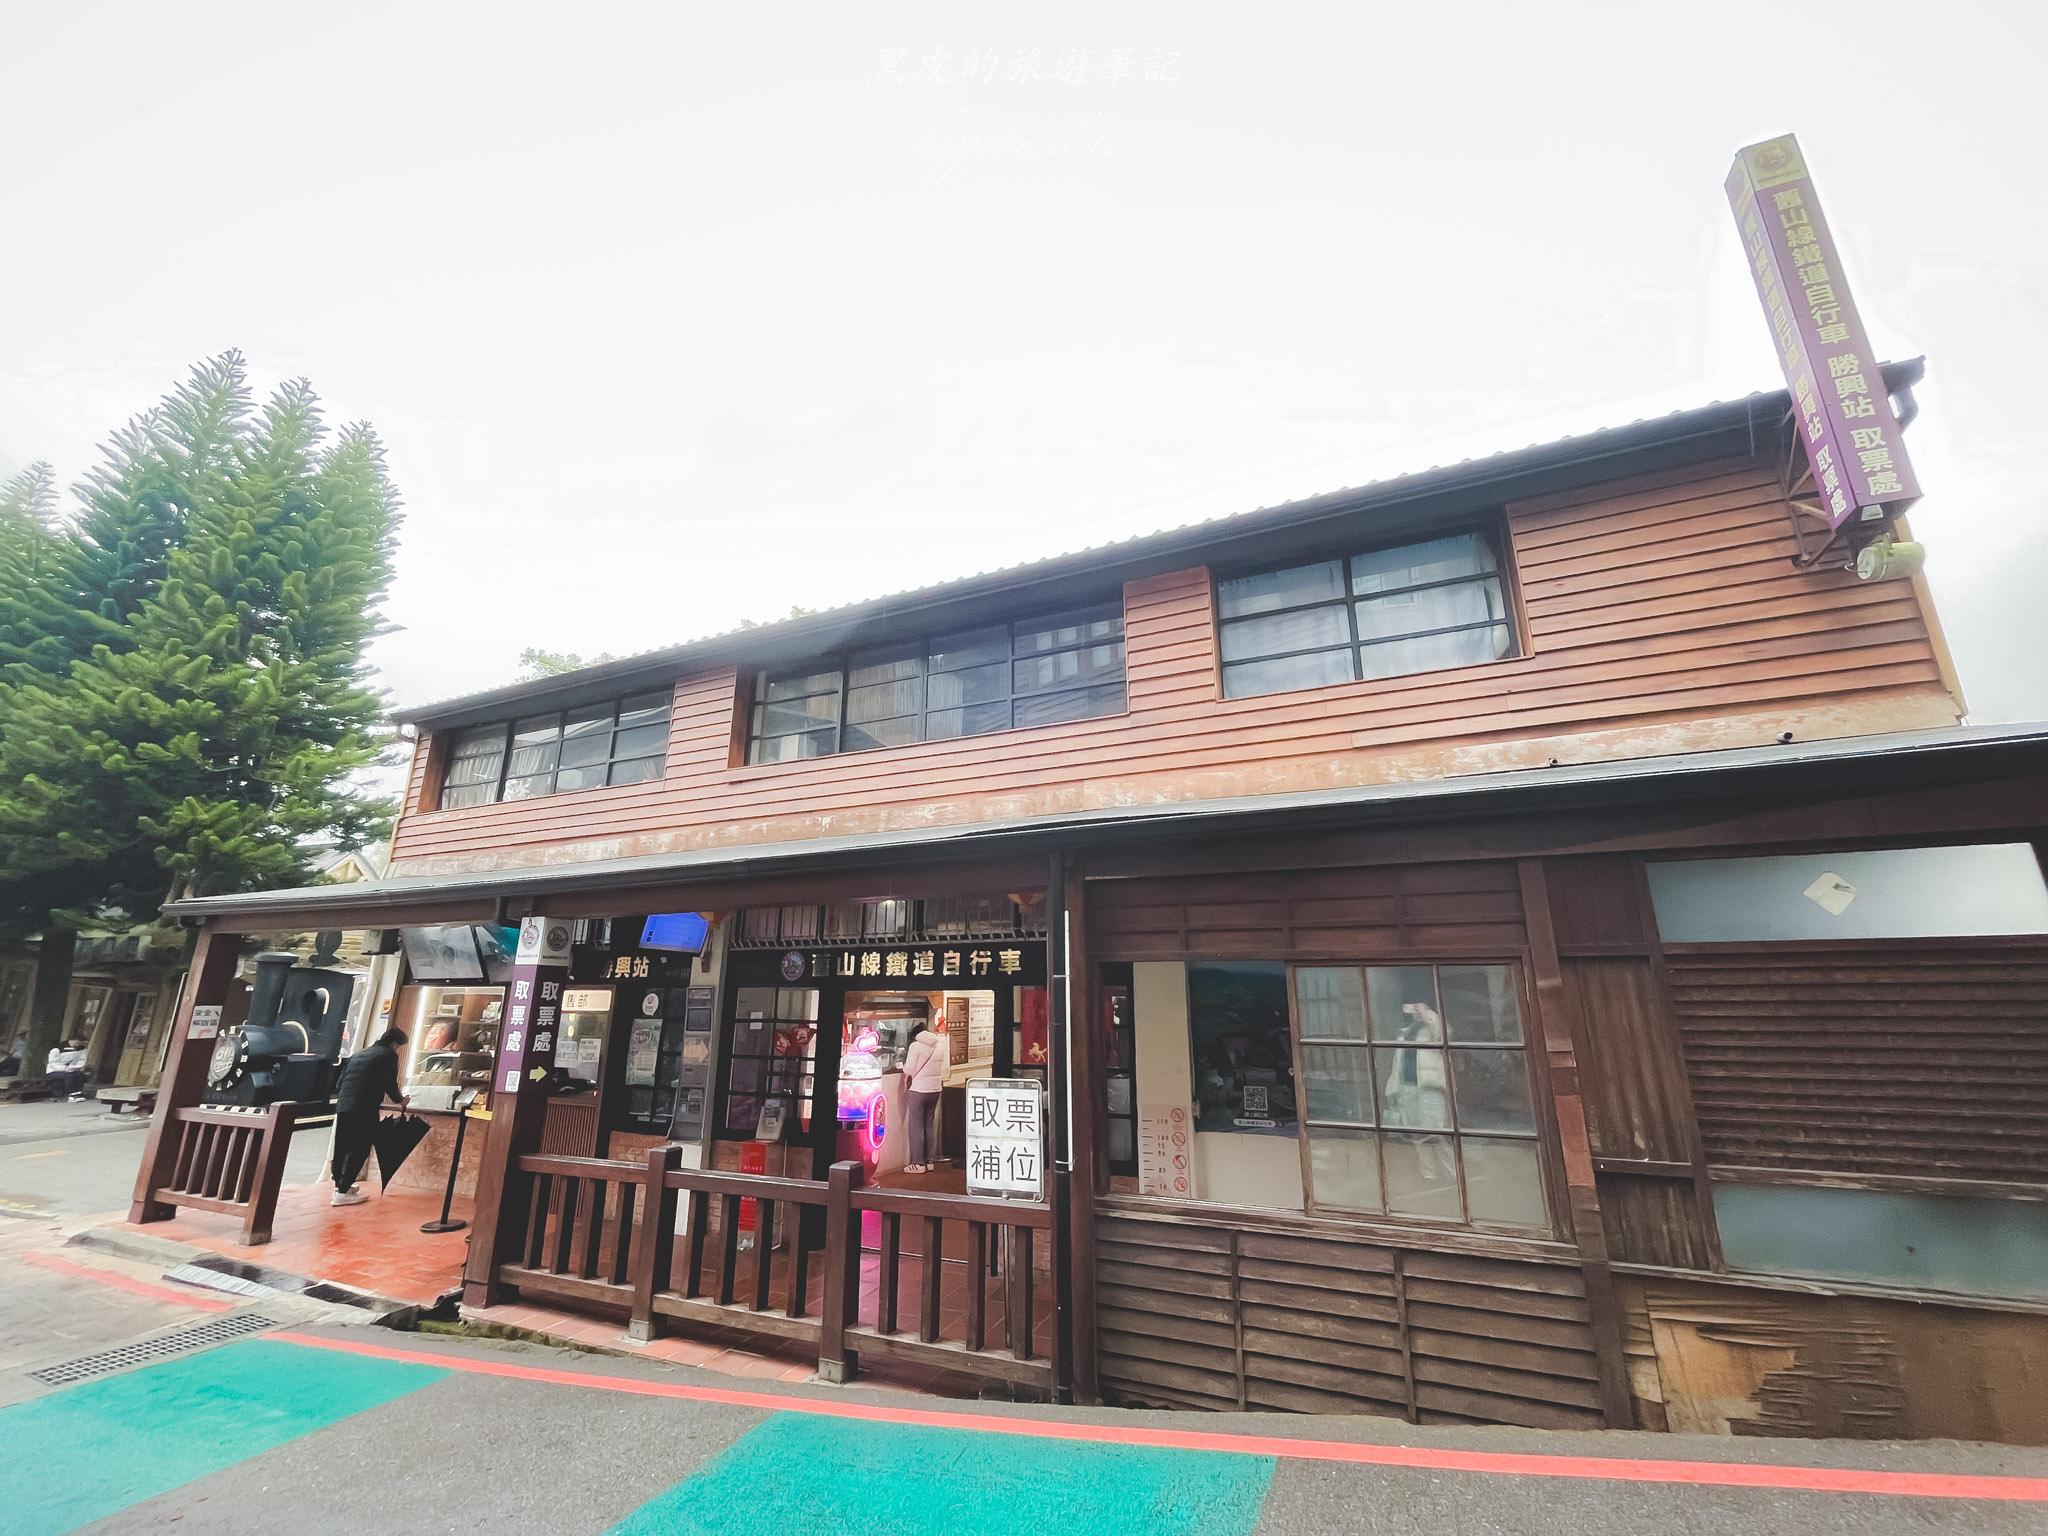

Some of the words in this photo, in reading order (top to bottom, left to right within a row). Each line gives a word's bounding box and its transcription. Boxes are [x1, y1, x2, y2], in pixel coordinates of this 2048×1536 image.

[1827, 353, 1875, 419] 勝興站
[1850, 425, 1902, 496] 取票處
[505, 980, 530, 1052] 取票處
[532, 981, 560, 1053] 取票處
[971, 1095, 1036, 1133] 取票
[971, 1144, 1038, 1182] 補位
